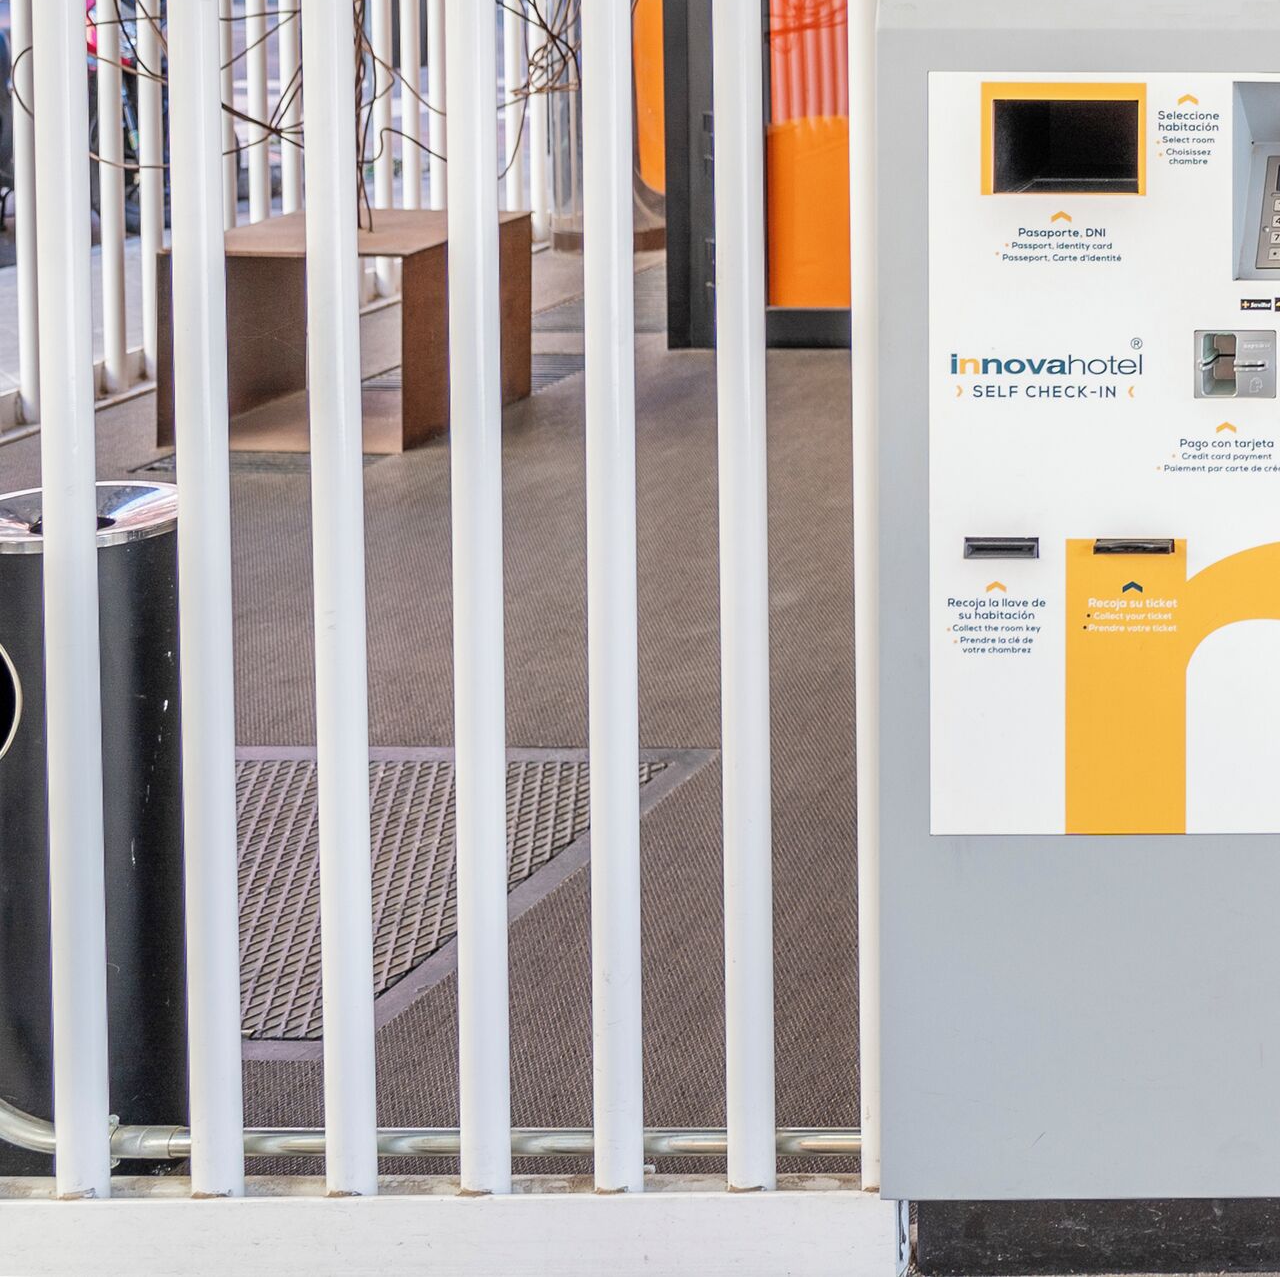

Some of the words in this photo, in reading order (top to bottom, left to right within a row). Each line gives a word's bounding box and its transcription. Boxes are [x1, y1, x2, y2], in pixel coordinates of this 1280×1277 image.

[1157, 110, 1220, 121] Seleccione
[1158, 122, 1219, 132] habitación
[1162, 135, 1190, 144] Select
[1165, 148, 1212, 156] Choisissez
[1168, 157, 1208, 165] chambre
[1018, 227, 1083, 239] Pasaporte,
[1085, 228, 1106, 237] DNI
[1011, 241, 1055, 252] Passport,
[1056, 241, 1090, 251] identity
[1092, 242, 1113, 250] card
[1002, 253, 1050, 263] Passeport,
[1052, 254, 1078, 262] Carte
[1079, 253, 1122, 262] d'identité
[950, 353, 1143, 375] innovahotel
[972, 385, 1019, 398] SELF
[1025, 385, 1117, 398] CHECK-IN
[1179, 438, 1209, 451] Pago
[1211, 440, 1232, 448] con
[1235, 438, 1275, 451] tarjeta
[1182, 452, 1209, 460] Credit
[1211, 452, 1232, 460] card
[1233, 453, 1272, 462] payment
[1164, 464, 1206, 472] Paiement
[1207, 465, 1223, 473] par
[1250, 464, 1261, 472] de
[947, 598, 986, 610] Recoja
[988, 598, 999, 607] la
[1001, 598, 1029, 607] llave
[1031, 598, 1047, 607] de
[1087, 597, 1127, 611] Recoja
[1129, 599, 1143, 608] su
[1145, 597, 1178, 608] ticket
[958, 612, 972, 620] su
[974, 610, 1035, 620] habitación
[1093, 612, 1124, 620] Collect
[1125, 613, 1146, 621] your
[1147, 612, 1173, 620] ticket
[952, 624, 982, 632] Collect
[984, 624, 999, 632] the
[1026, 624, 1042, 633] key
[1088, 624, 1125, 632] Prendre
[1126, 624, 1151, 632] votre
[1152, 623, 1177, 632] ticket
[960, 636, 997, 644] Prendre
[1008, 636, 1021, 644] clé
[1022, 636, 1034, 644] de
[962, 646, 986, 654] votre
[987, 646, 1032, 654] chambrez
